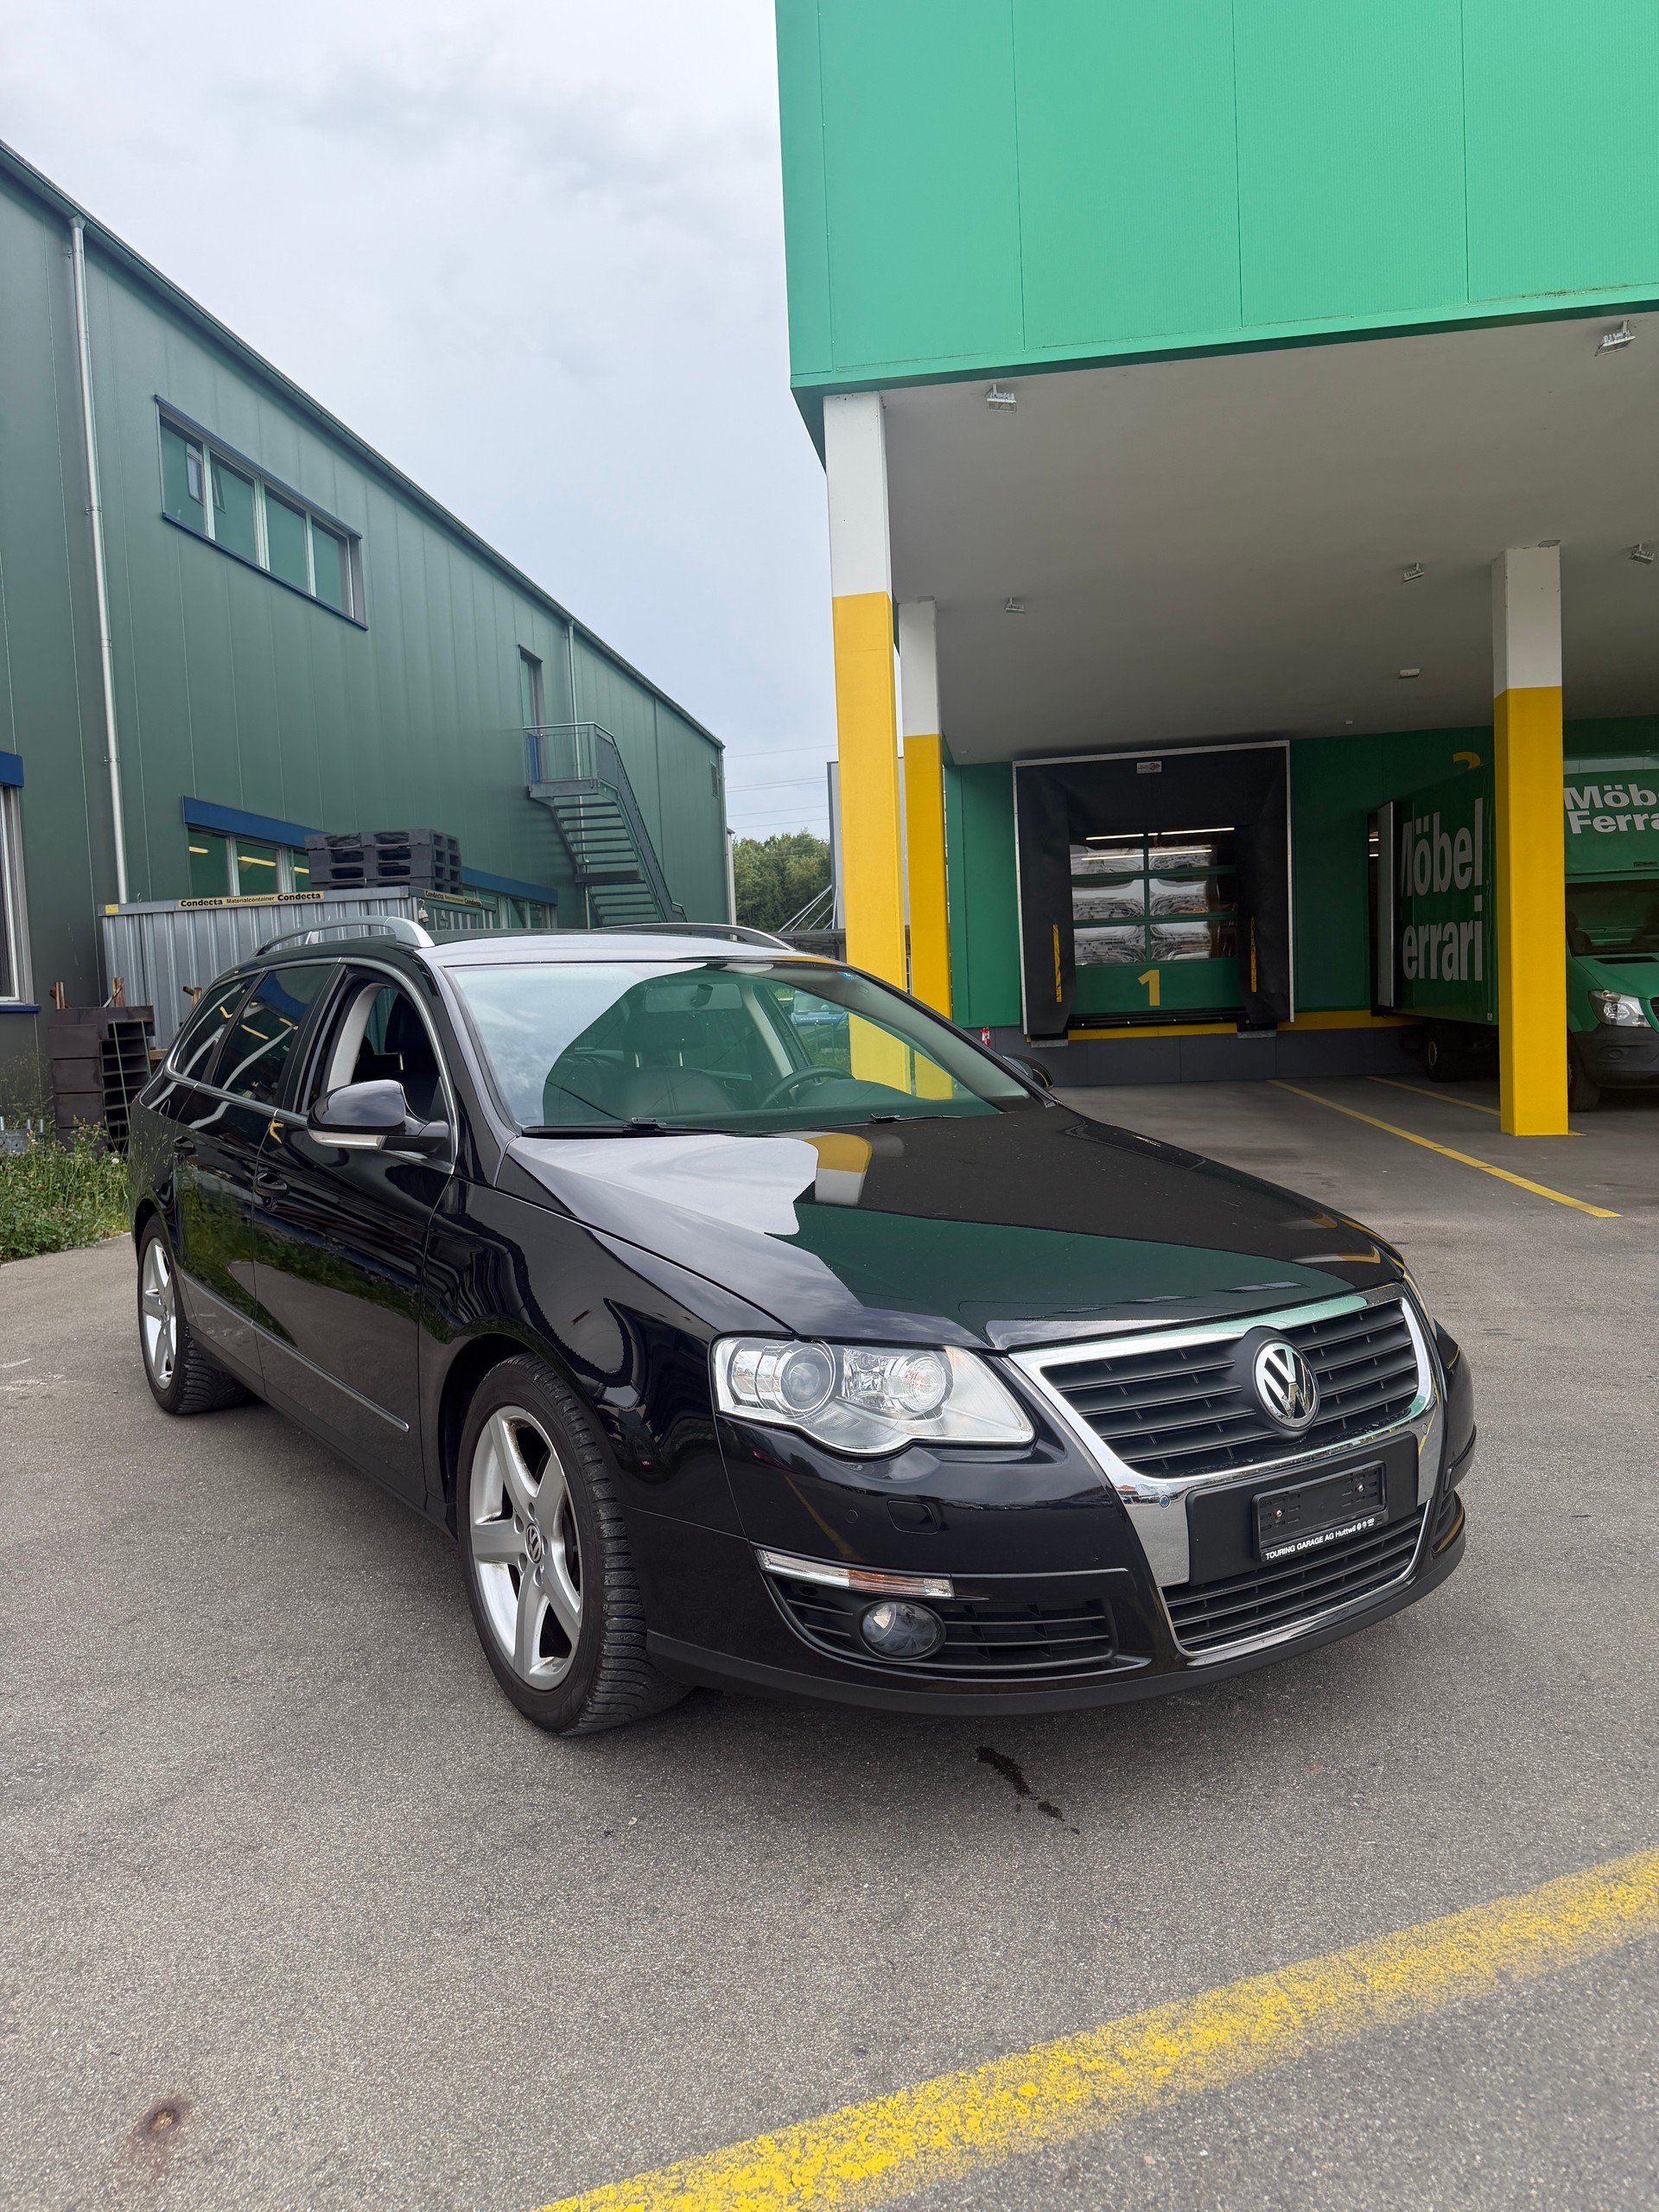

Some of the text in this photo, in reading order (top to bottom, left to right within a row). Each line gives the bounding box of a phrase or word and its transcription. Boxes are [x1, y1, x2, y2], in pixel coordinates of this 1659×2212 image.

[1563, 784, 1659, 810] Möb
[181, 893, 321, 907] Condecta Materialcontainer Condecta
[1402, 894, 1484, 982] errari
[1138, 969, 1160, 1006] 1
[1255, 1343, 1316, 1427] VW
[1265, 1524, 1357, 1560] TOURING GARAGE AG Huttwil
